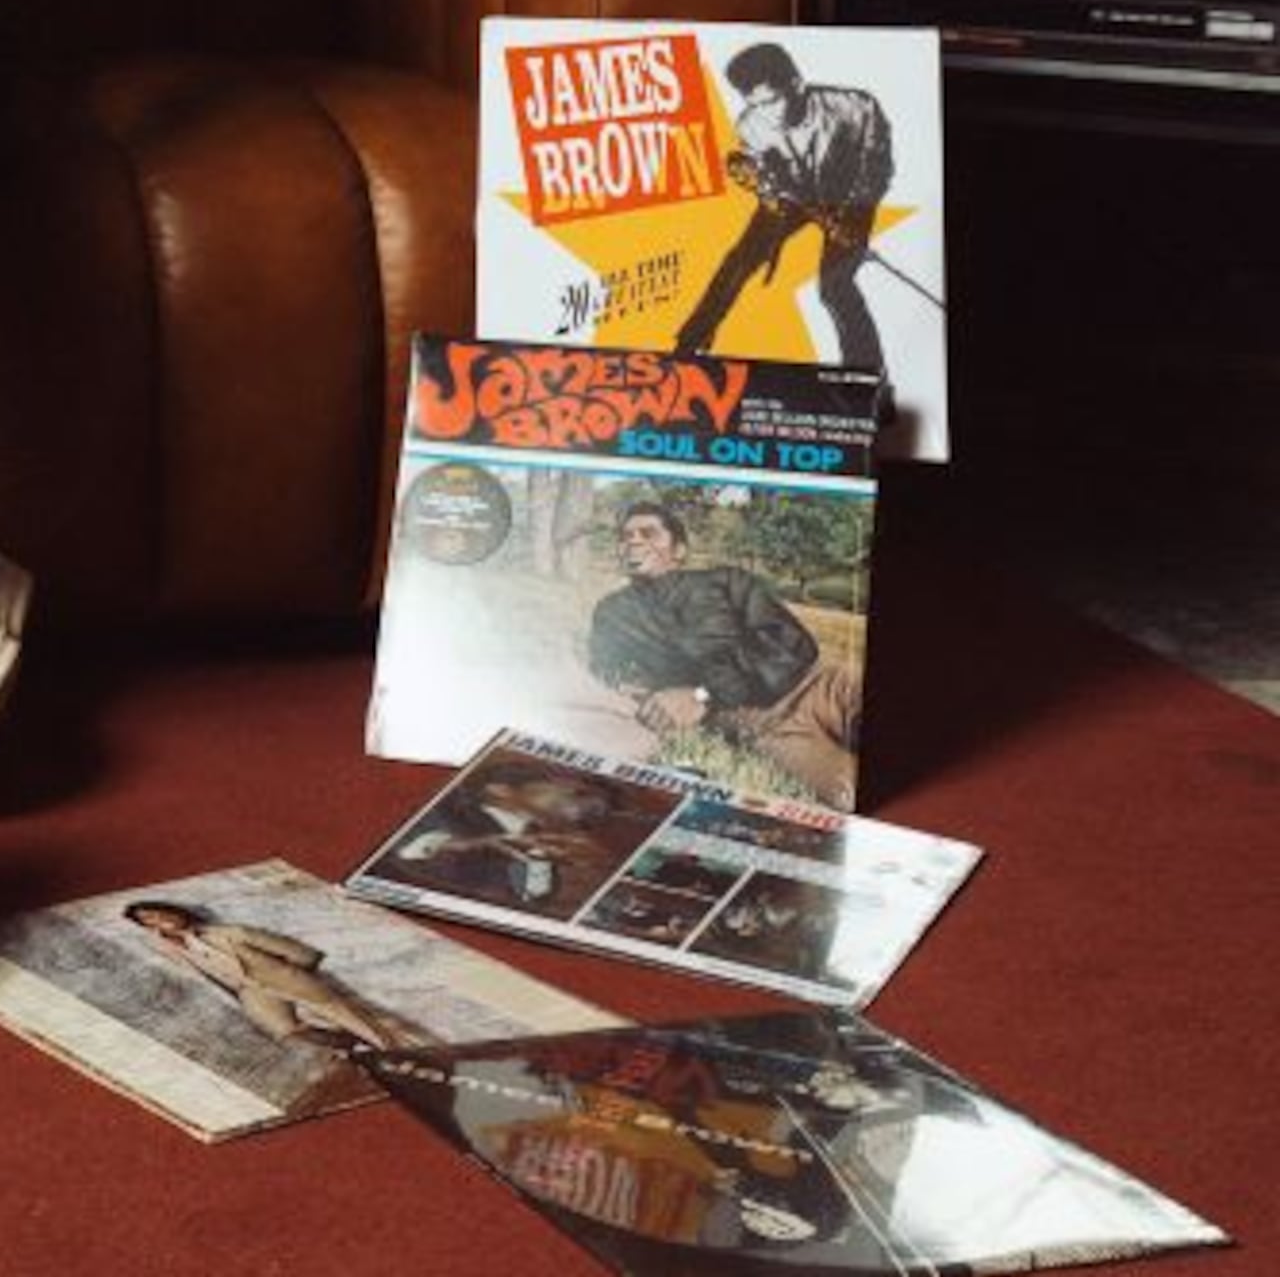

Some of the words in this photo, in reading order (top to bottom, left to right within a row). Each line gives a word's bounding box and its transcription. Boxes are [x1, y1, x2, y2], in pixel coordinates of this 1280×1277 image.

[524, 39, 683, 125] JAMES
[531, 122, 713, 213] BROWN
[493, 361, 749, 448] BROWN
[618, 429, 702, 461] SOUL
[710, 438, 764, 466] ON
[776, 441, 843, 470] TOP
